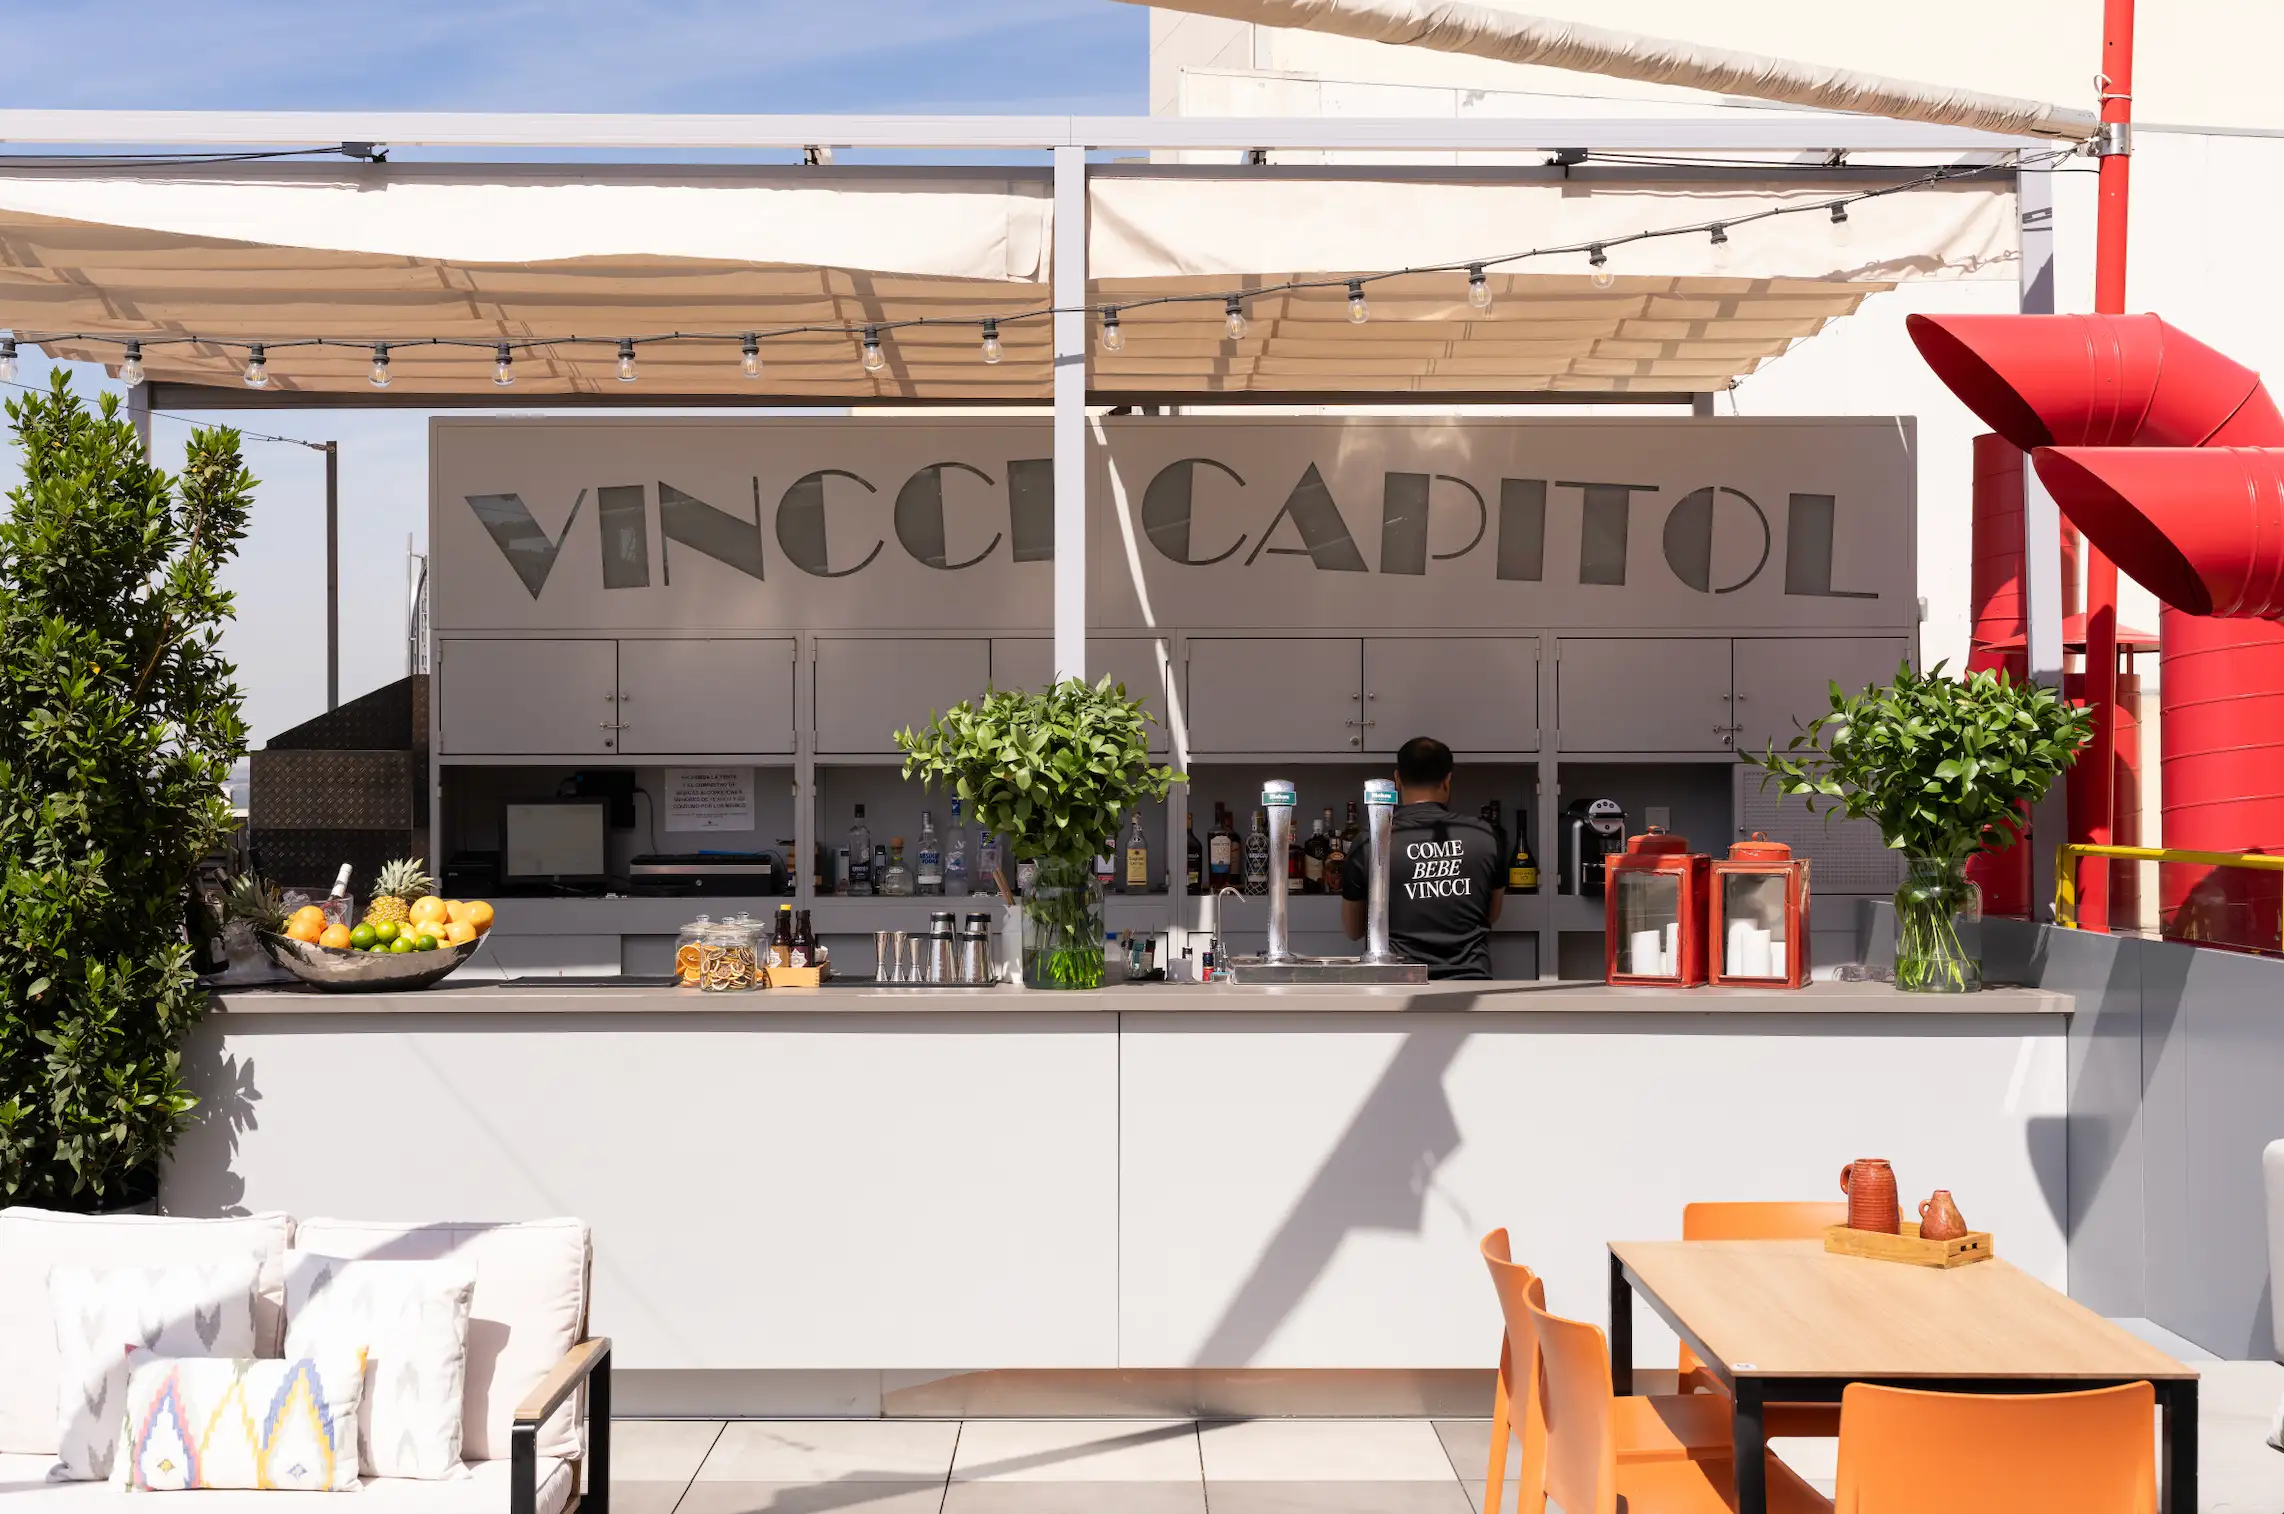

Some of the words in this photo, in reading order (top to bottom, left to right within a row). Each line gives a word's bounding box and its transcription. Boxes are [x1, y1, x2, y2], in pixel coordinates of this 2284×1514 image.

[464, 458, 1054, 600] VINCCI
[1141, 458, 1879, 600] CAPITOL
[1406, 839, 1464, 860] COME
[1412, 859, 1463, 879] BEBE
[1403, 878, 1472, 900] VINCCI
